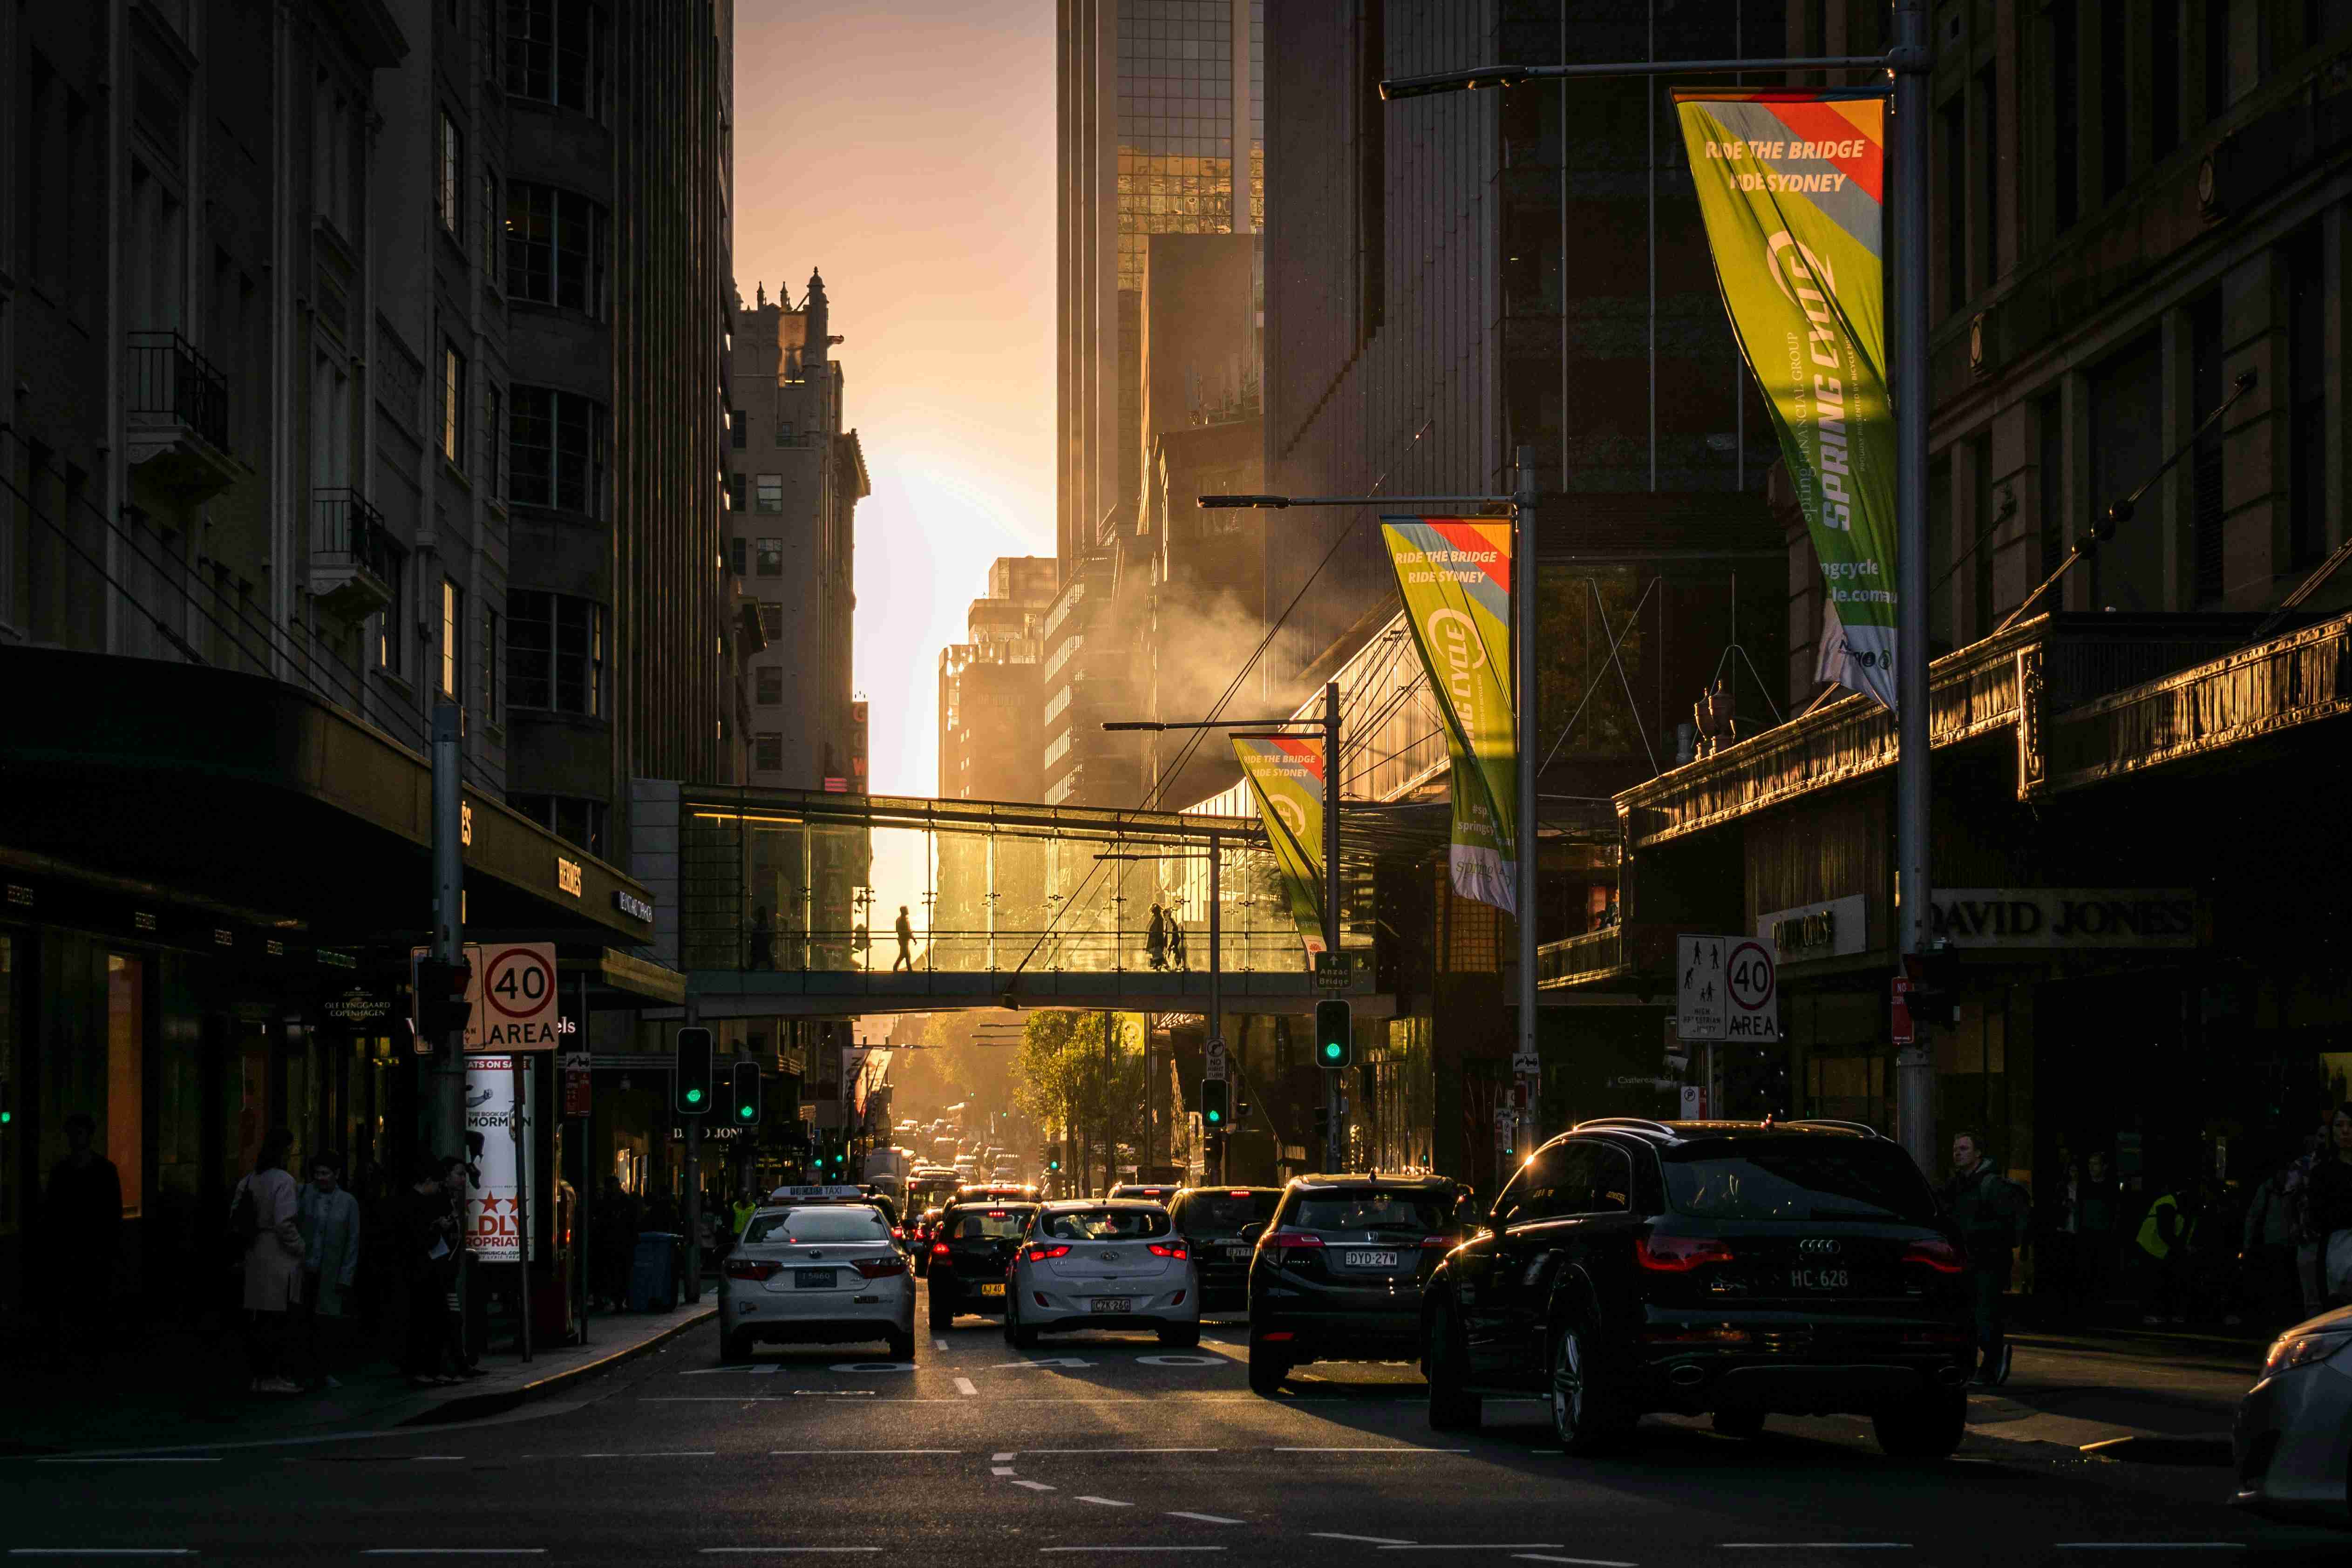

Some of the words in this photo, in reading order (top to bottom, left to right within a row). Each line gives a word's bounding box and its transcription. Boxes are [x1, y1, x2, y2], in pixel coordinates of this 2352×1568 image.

[1749, 141, 1783, 159] THE
[1788, 140, 1865, 159] BRIDGE
[1767, 174, 1847, 192] SYDNEY
[1787, 332, 1802, 380] GROUP
[1847, 350, 1858, 381] BICYCLE
[1852, 383, 1860, 392] BY
[1794, 384, 1812, 463] FINANCIAL
[1853, 393, 1864, 436] PRESENTED
[1813, 373, 1851, 532] SPRING
[1856, 436, 1866, 472] PROUDLY
[1395, 552, 1423, 563] RIDE
[1426, 551, 1448, 563] THE
[1449, 551, 1497, 563] BRIDGE
[1408, 572, 1435, 584] RIDE
[1438, 572, 1485, 583] SYDNEY
[1446, 624, 1471, 698] CYCLE
[1264, 755, 1281, 763] THE
[1282, 754, 1316, 764] BRIDGE
[1272, 769, 1308, 777] SYDNEY
[1319, 968, 1349, 977] Anzac
[1733, 961, 1768, 993] 40
[495, 966, 545, 1000] 40
[1319, 977, 1349, 987] Bridge
[330, 1009, 387, 1018] COPENHAGEN
[489, 1022, 556, 1044] AREA
[1729, 1016, 1775, 1036] AREA
[469, 1117, 531, 1127] MORMN
[714, 1128, 743, 1139] JON
[826, 1186, 843, 1195] TAXI
